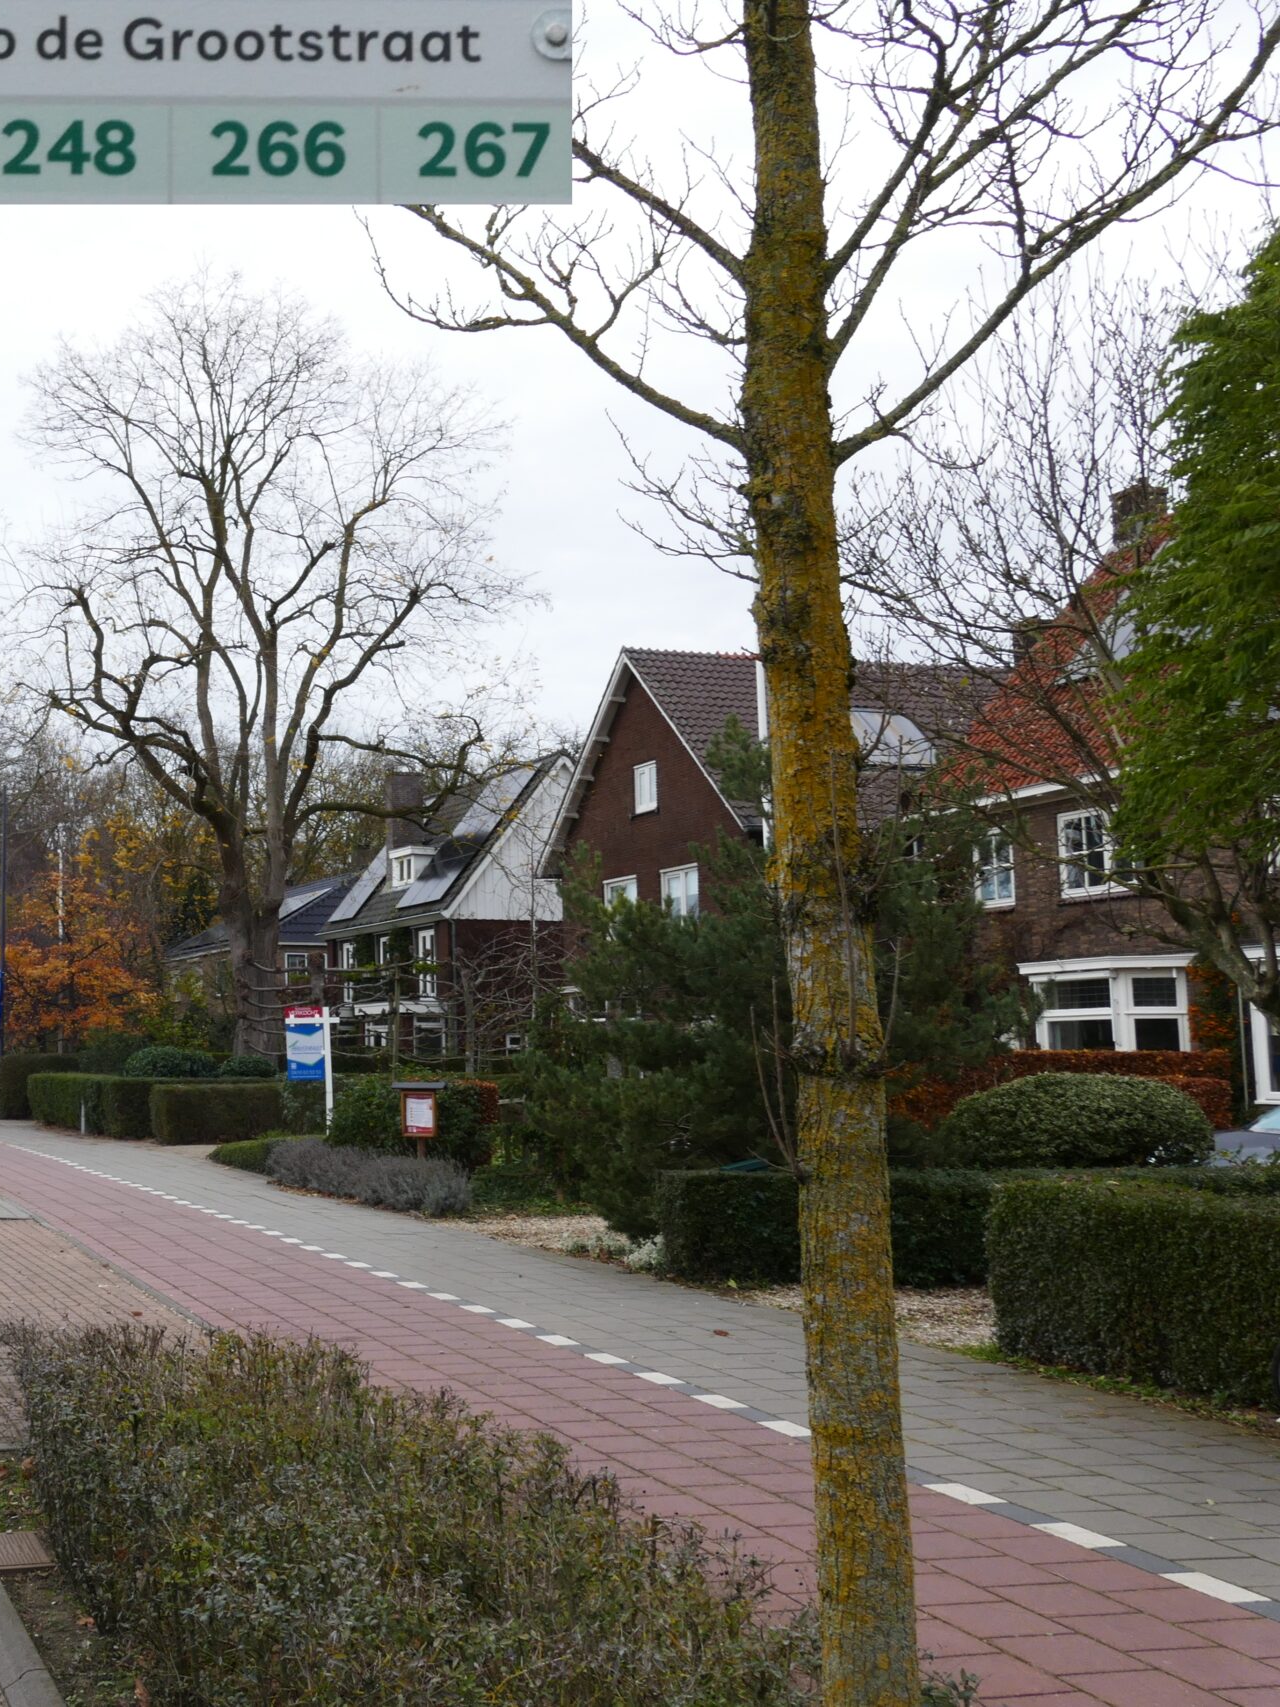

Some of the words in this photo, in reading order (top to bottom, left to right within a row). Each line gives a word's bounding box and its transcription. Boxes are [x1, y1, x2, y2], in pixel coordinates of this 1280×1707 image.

[35, 14, 104, 61] de
[122, 16, 482, 63] Grootstraat
[1, 118, 137, 177] 248
[210, 120, 347, 178] 266
[417, 121, 551, 179] 267
